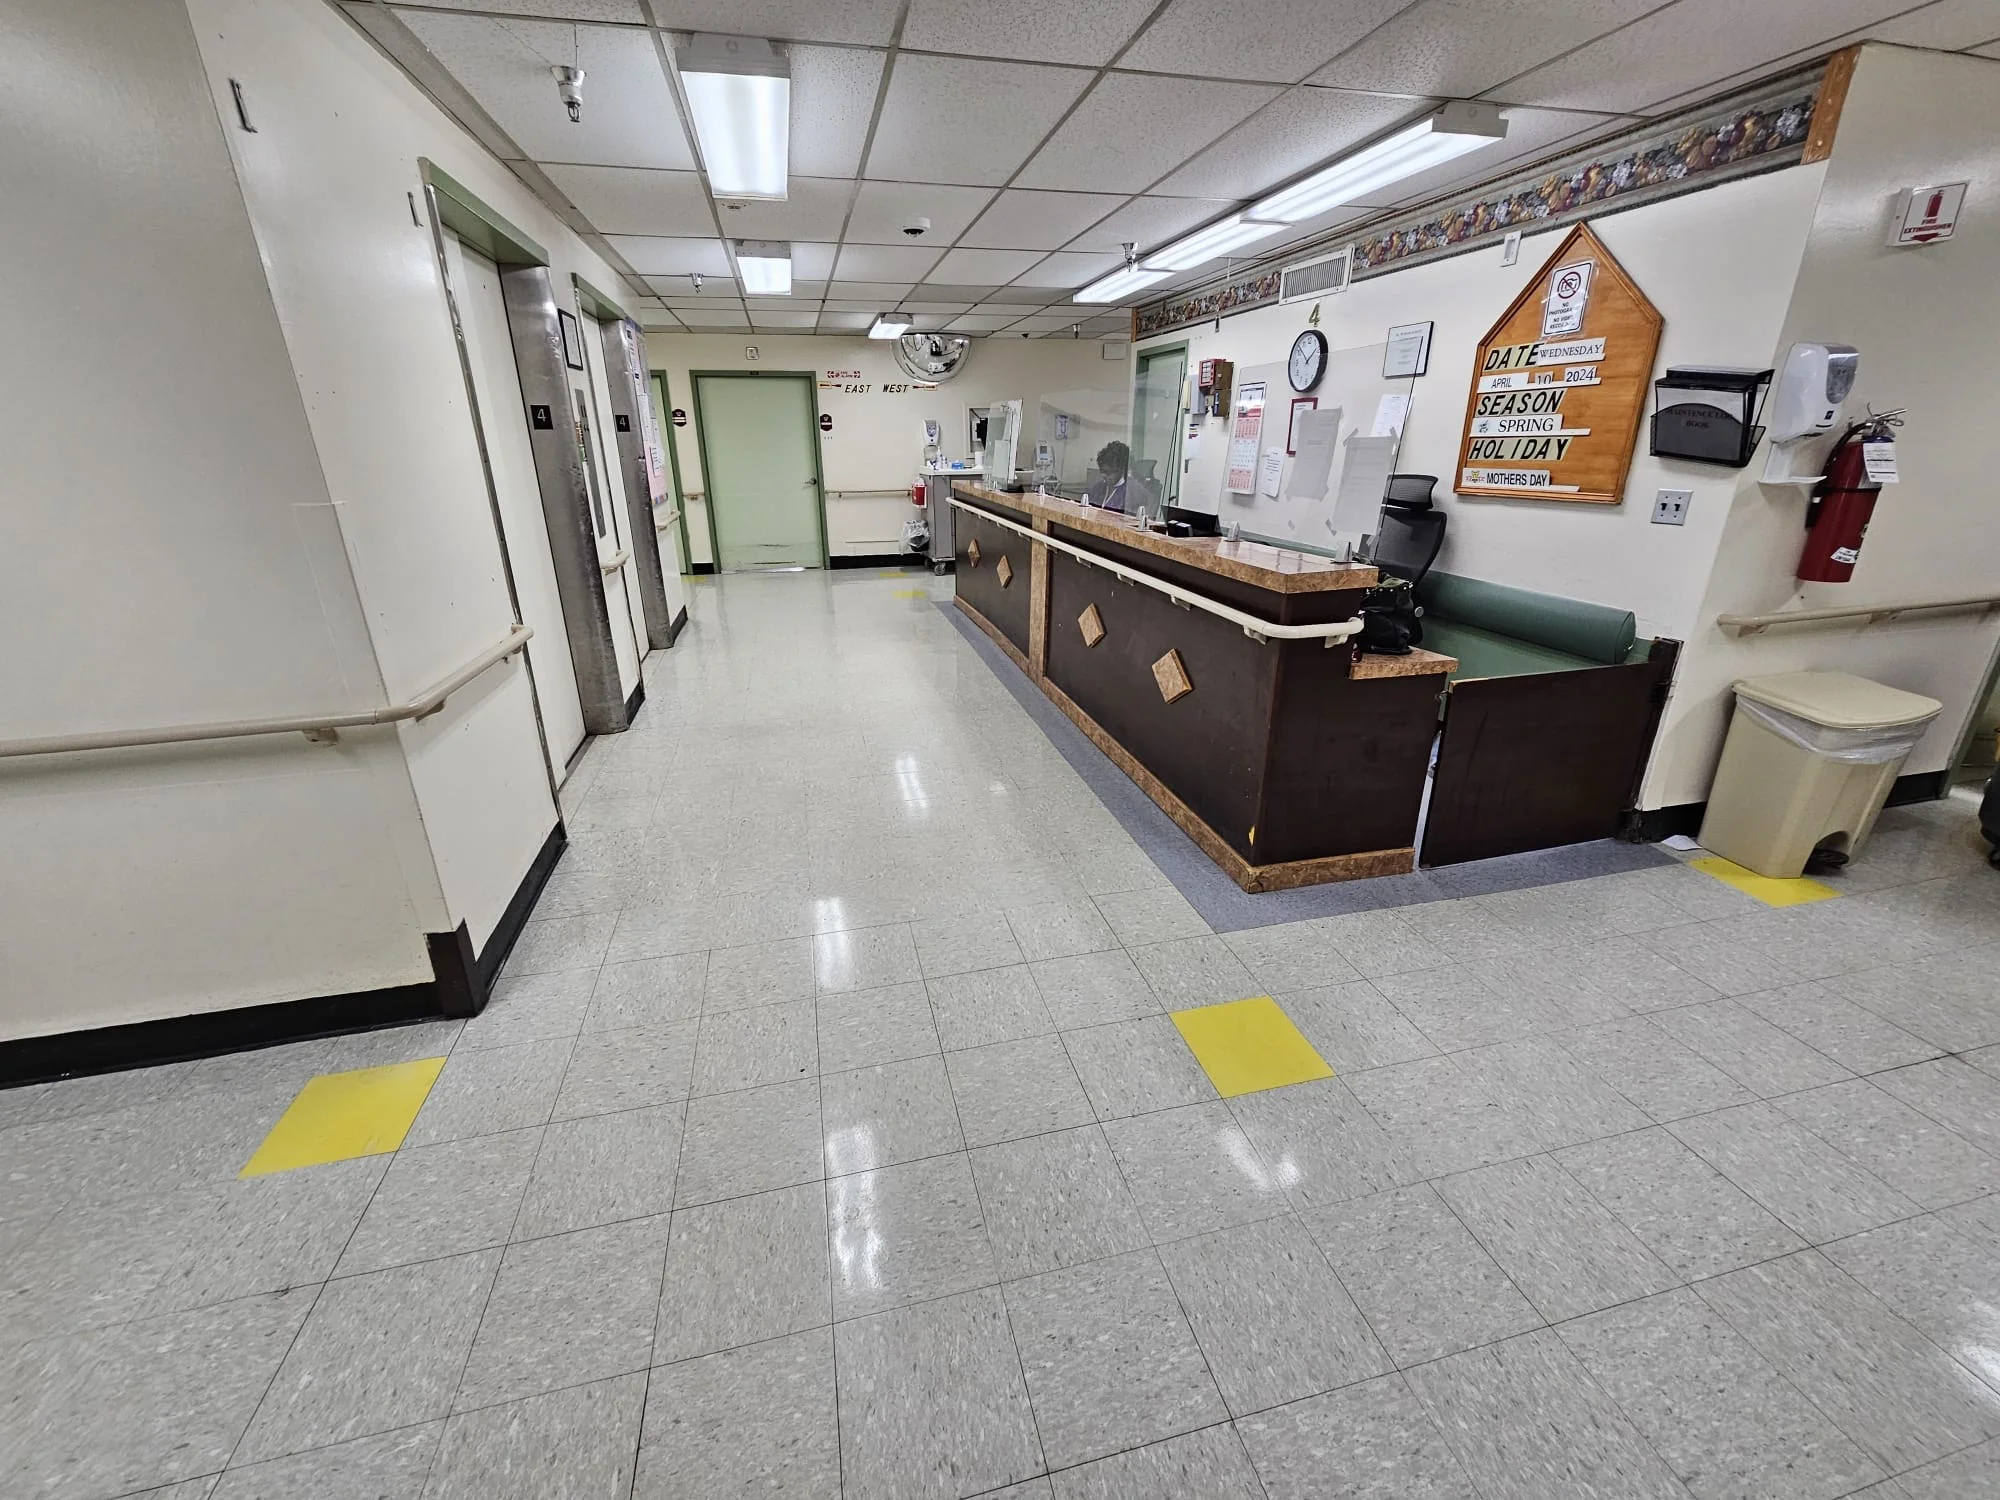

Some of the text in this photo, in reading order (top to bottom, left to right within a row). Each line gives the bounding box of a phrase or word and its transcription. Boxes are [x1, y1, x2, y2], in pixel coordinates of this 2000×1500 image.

[1308, 302, 1321, 328] 4
[1485, 343, 1603, 370] DATE WEDNESDAY
[1491, 367, 1596, 389] APRIL 10 2024
[844, 383, 910, 393] EAST WEST
[1477, 390, 1565, 416] SEASON
[537, 408, 547, 422] 4
[619, 416, 627, 427] 4
[1497, 417, 1554, 433] SPRING
[1468, 438, 1569, 460] HOLIDAY
[1486, 472, 1548, 487] MOTHERS DAY
